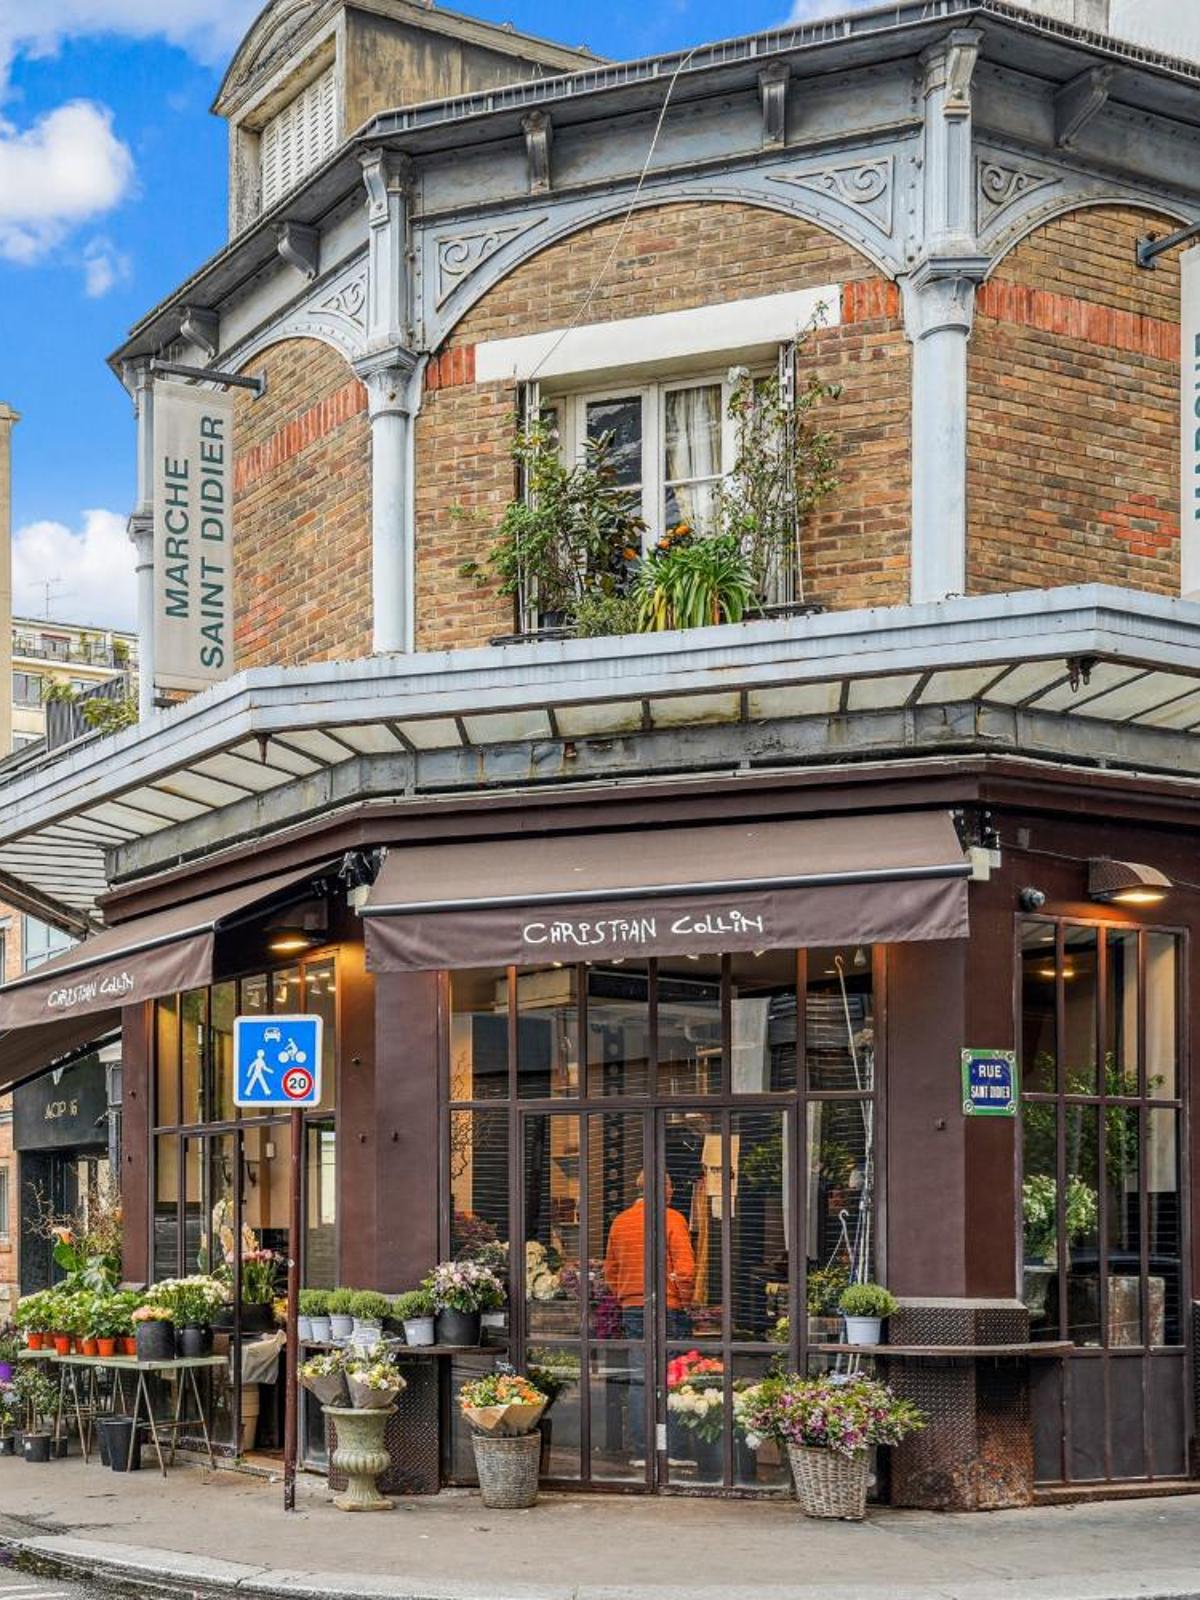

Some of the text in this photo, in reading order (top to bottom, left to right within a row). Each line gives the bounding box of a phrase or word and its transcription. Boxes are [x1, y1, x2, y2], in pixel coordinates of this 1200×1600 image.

[164, 456, 189, 619] MARCHE
[200, 416, 224, 668] SAINT DIDIER
[289, 1077, 307, 1089] 20
[978, 1064, 1003, 1078] RUE
